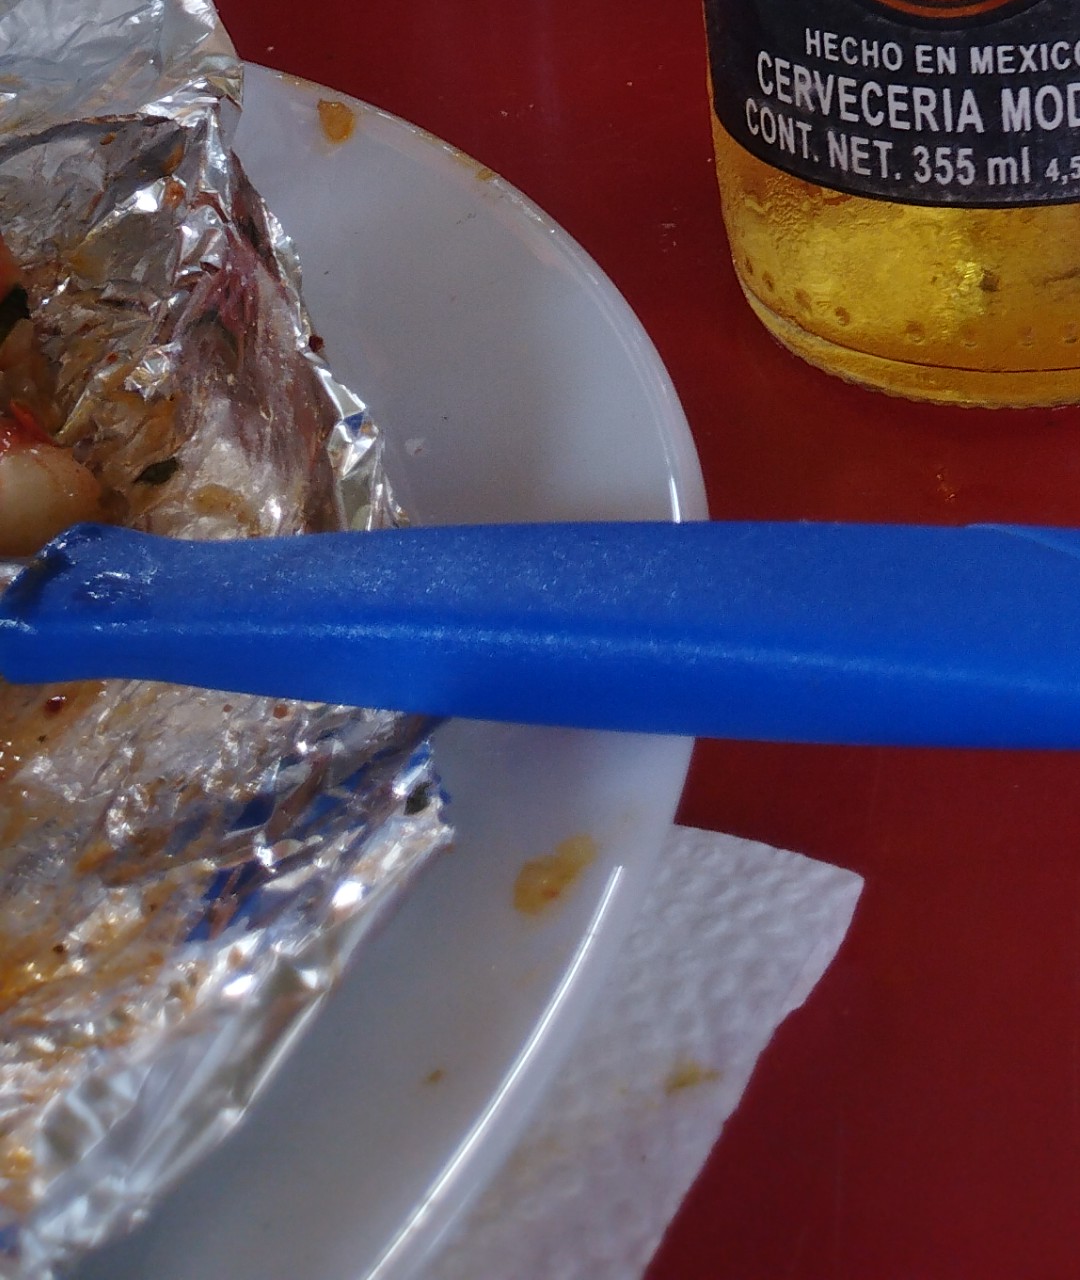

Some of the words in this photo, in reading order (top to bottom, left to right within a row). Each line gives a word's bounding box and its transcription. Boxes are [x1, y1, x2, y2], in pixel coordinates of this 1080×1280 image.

[756, 50, 986, 134] CERVECERIA
[805, 26, 903, 72] HECHO
[914, 44, 957, 75] EN
[745, 97, 820, 163] CONT.
[826, 130, 901, 181] NET.
[912, 144, 976, 186] 355
[986, 146, 1032, 186] ml
